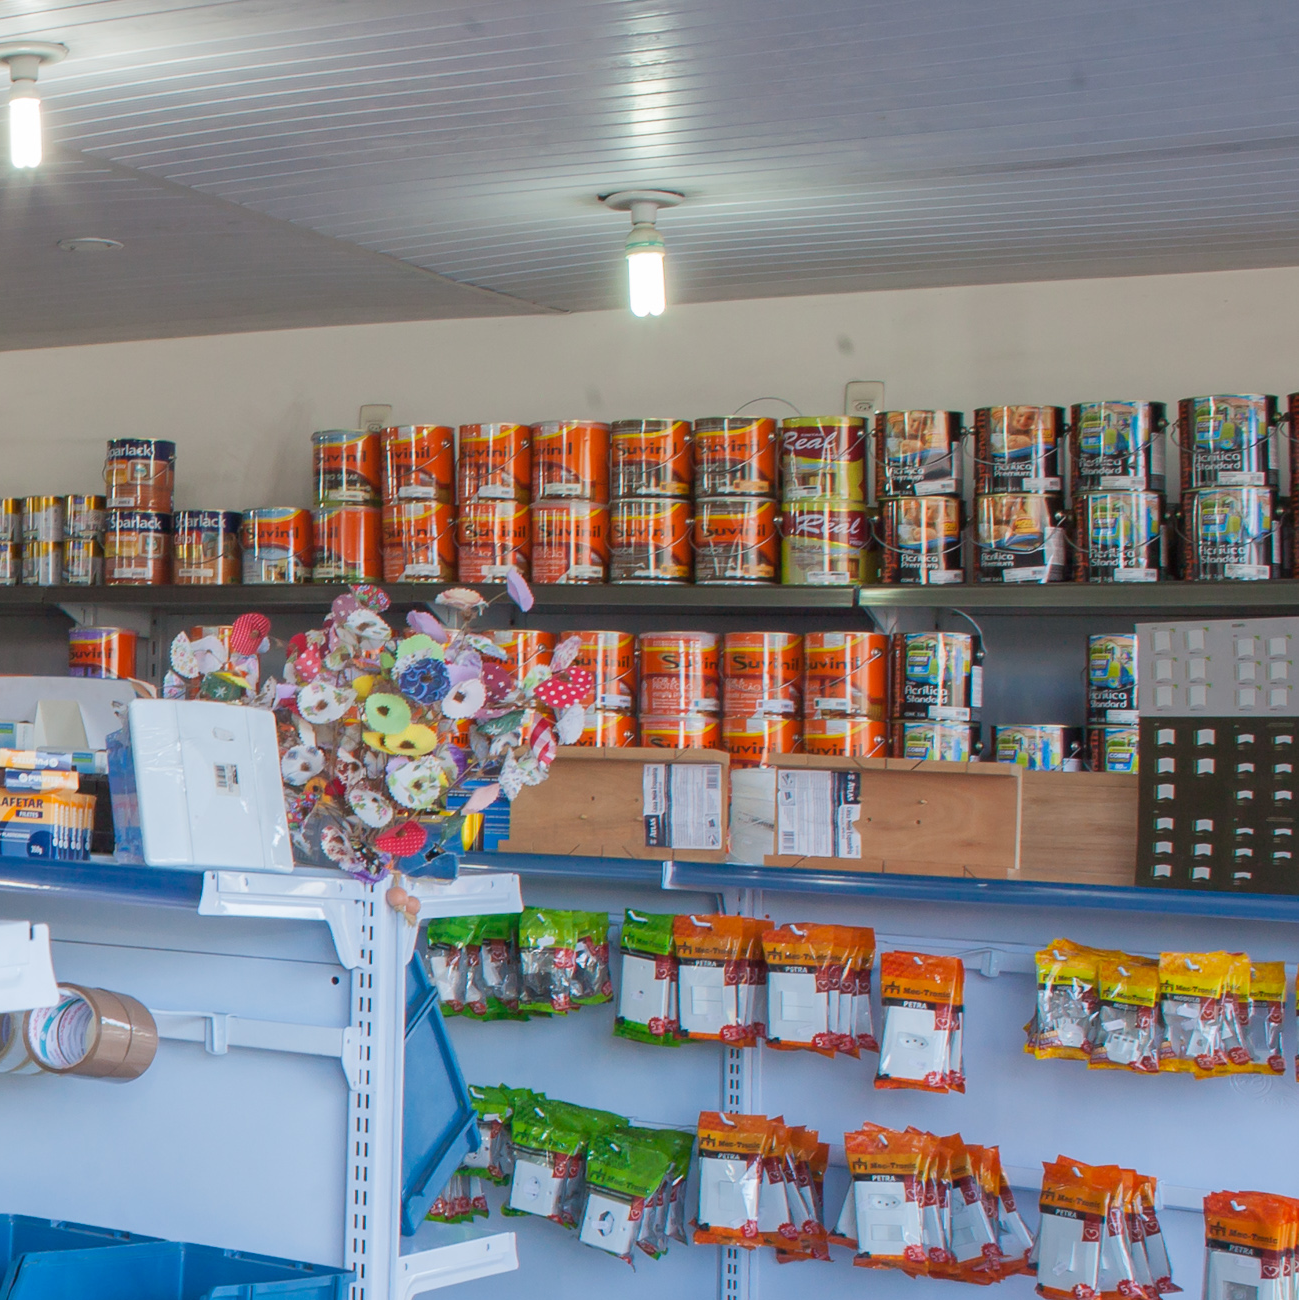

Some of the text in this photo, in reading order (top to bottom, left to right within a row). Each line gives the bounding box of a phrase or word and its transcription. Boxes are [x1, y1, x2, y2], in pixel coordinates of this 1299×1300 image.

[783, 431, 838, 451] Real
[615, 442, 678, 456] Suvinil
[110, 515, 162, 530] Sparlack
[175, 514, 226, 529] Sparlack
[796, 513, 861, 535] Real
[732, 654, 800, 671] Suvinil
[906, 695, 948, 705] Standard
[903, 1001, 928, 1010] PETRA
[871, 1174, 897, 1183] PETRA
[1055, 1208, 1078, 1219] PETRA
[1228, 1244, 1255, 1256] PETRA
